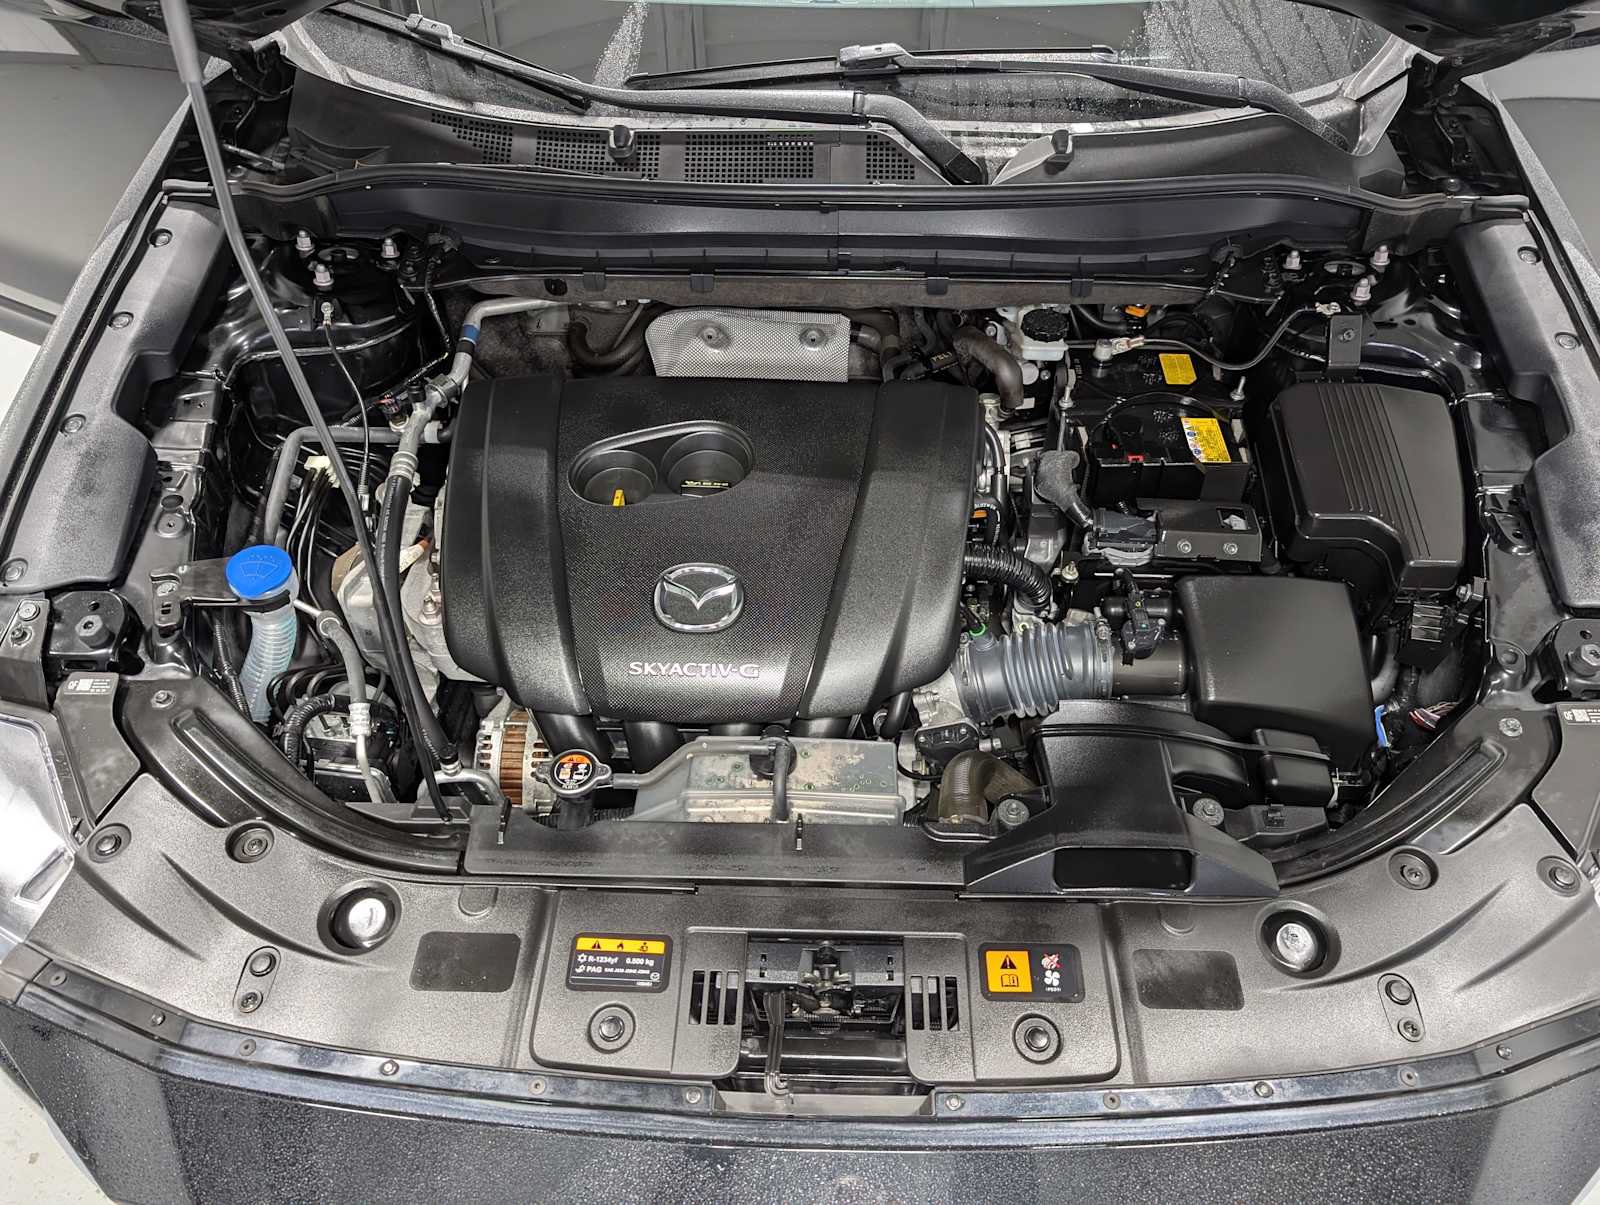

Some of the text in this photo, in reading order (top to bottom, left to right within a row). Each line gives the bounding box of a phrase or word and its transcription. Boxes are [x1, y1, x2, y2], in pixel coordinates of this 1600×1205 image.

[629, 662, 759, 678] SKYACTIV-G
[588, 955, 619, 965] R-1234yf
[645, 958, 654, 966] kg
